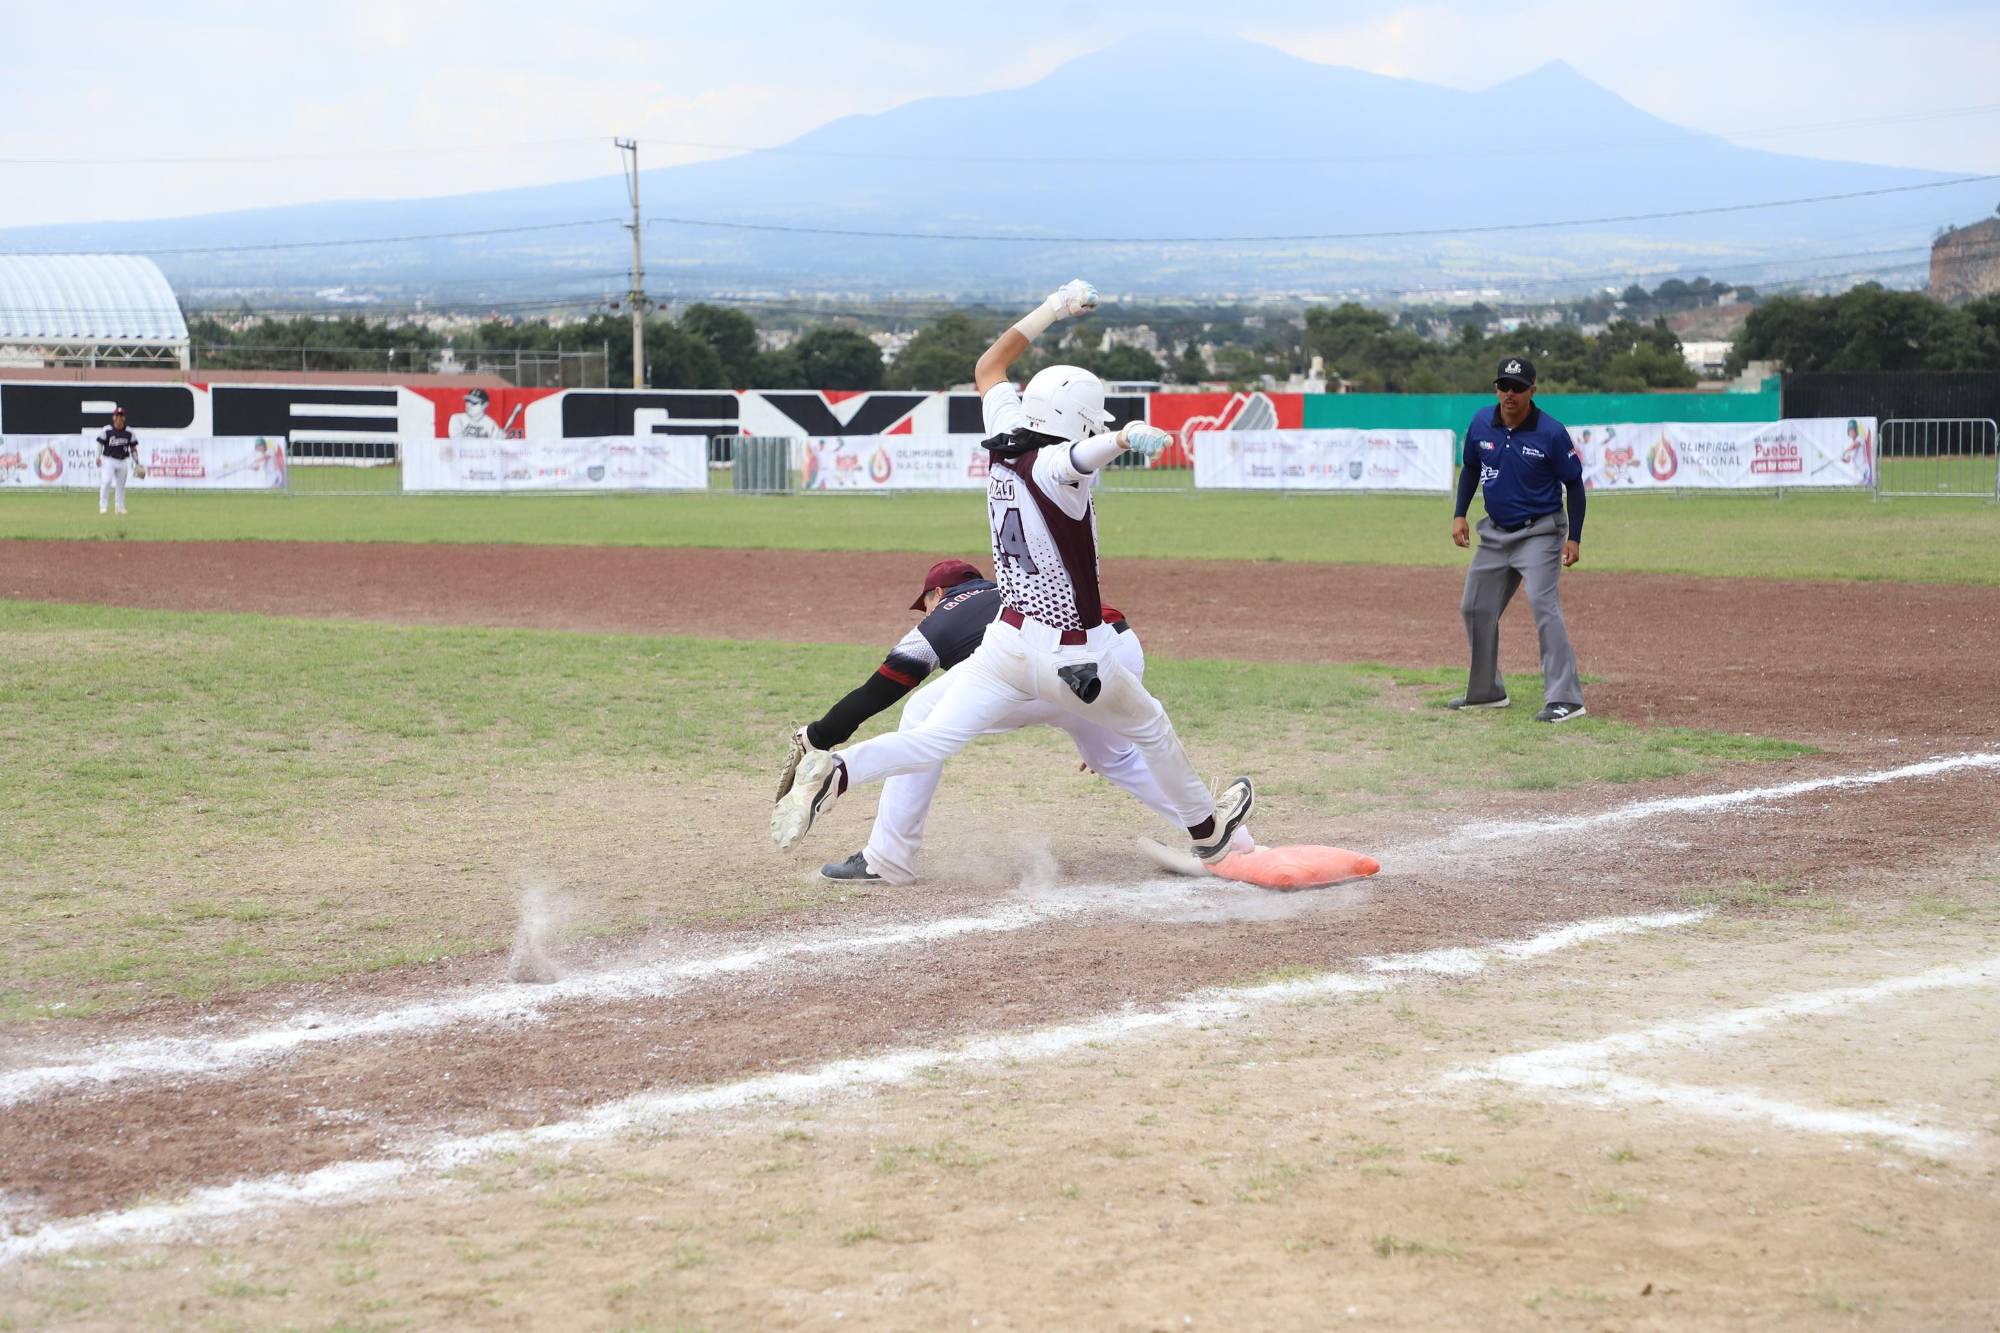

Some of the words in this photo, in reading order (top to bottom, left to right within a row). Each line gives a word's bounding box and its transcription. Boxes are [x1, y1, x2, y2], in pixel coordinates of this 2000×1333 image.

[1755, 443, 1799, 456] Puebla
[152, 453, 200, 465] Puebla
[1683, 456, 1742, 466] NACIONAL
